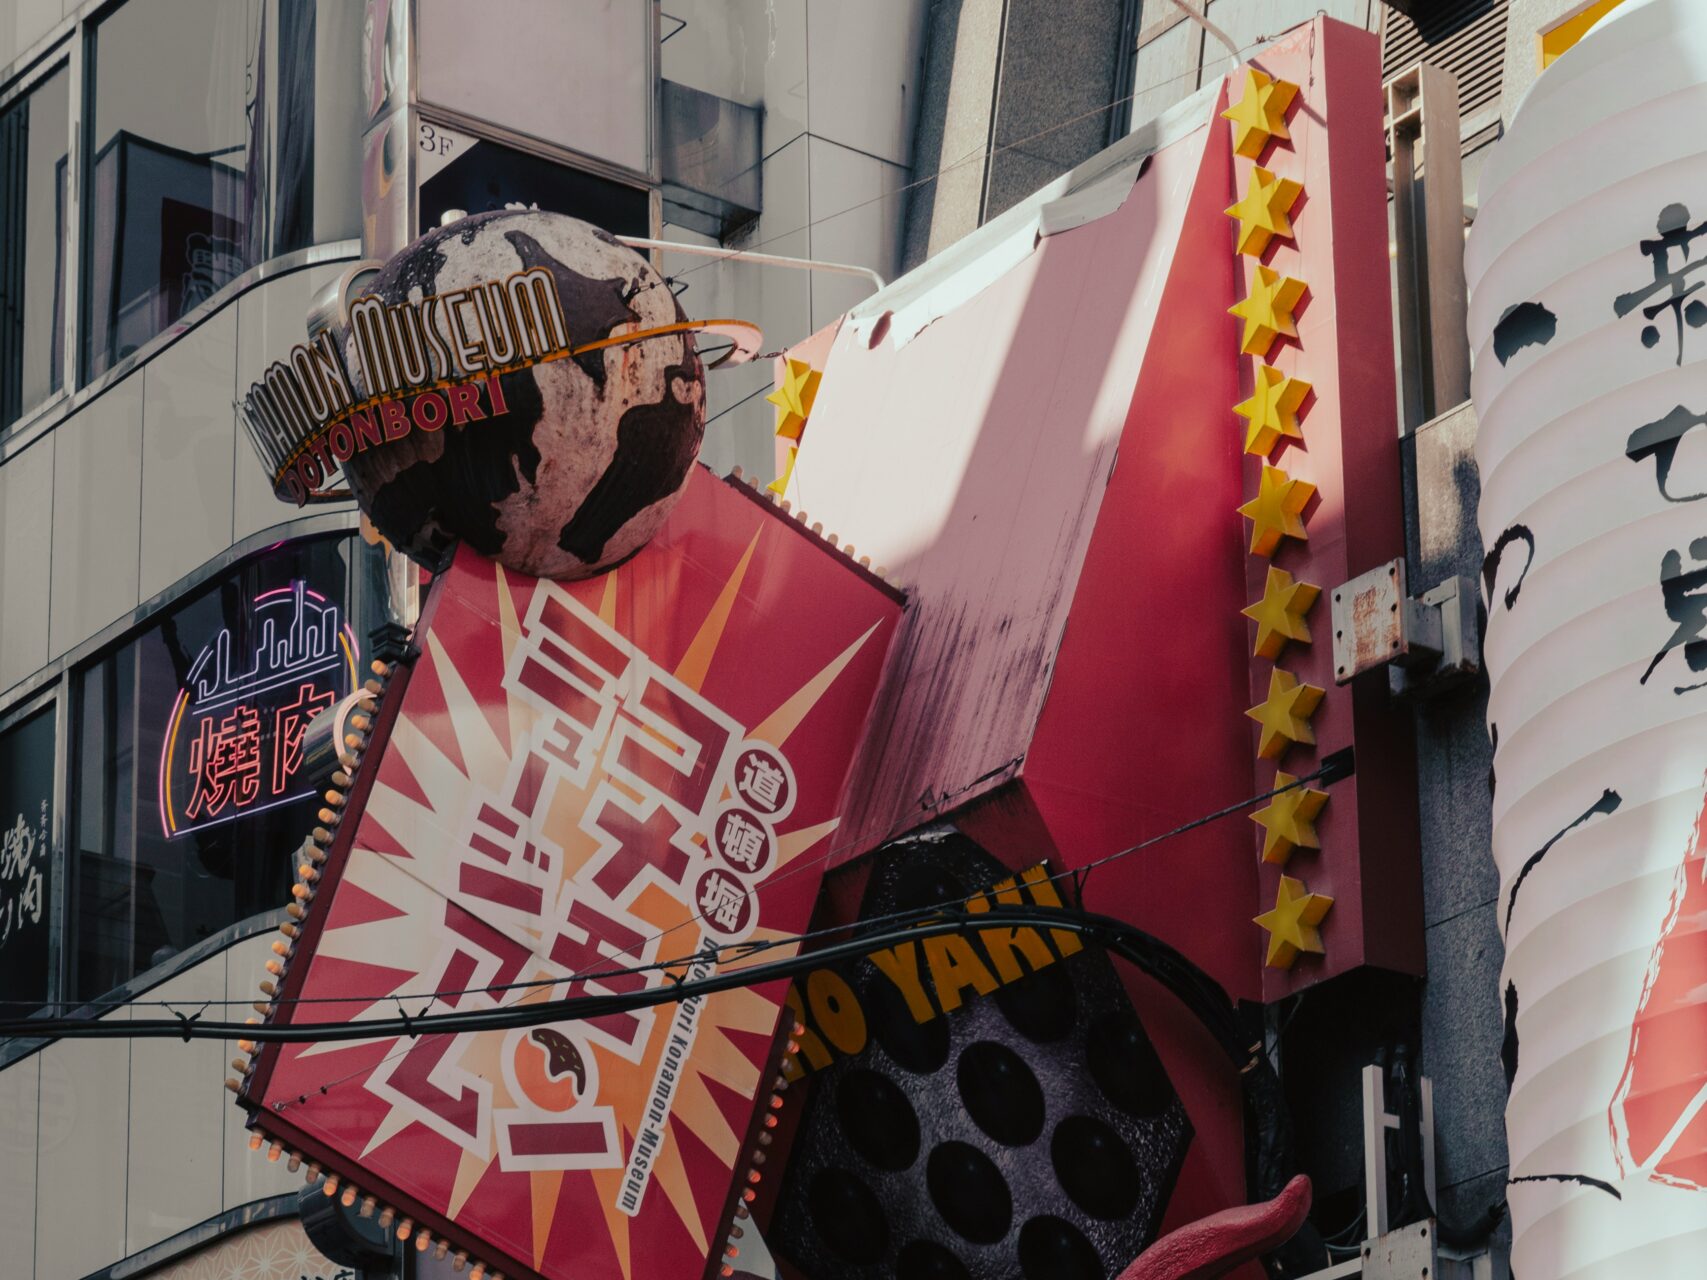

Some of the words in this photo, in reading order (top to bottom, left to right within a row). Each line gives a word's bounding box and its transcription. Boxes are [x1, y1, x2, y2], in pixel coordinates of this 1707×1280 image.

[420, 124, 453, 156] 3F
[352, 267, 571, 396] MUSEUM
[284, 373, 509, 508] DOTONBORI
[700, 753, 785, 932] 道頓堀
[867, 863, 1083, 1025] YAKI
[622, 1034, 689, 1211] Konamon-Museum
